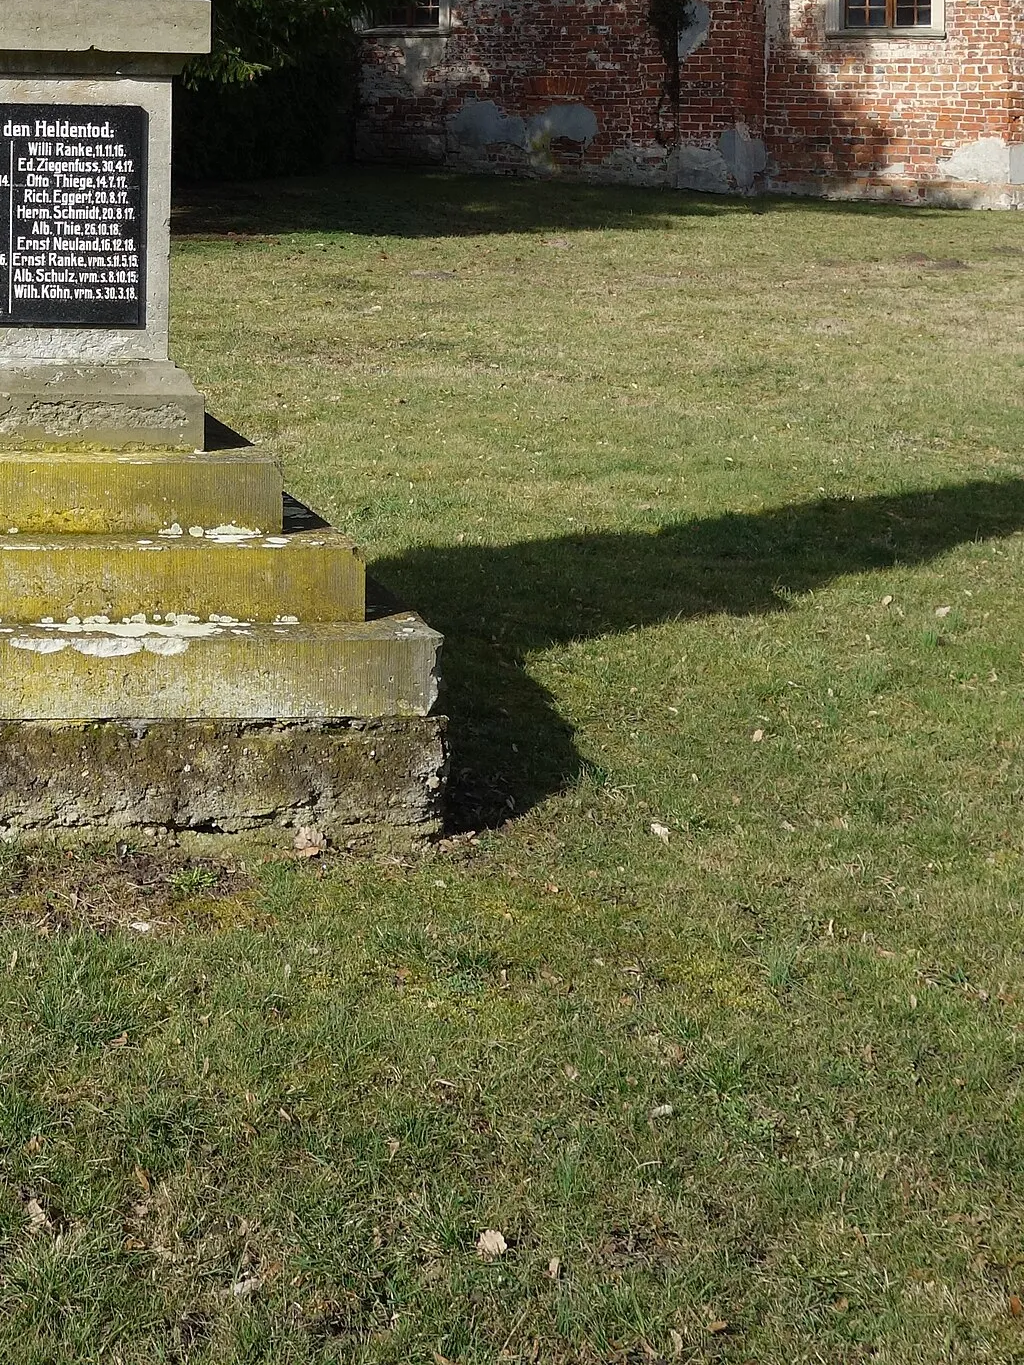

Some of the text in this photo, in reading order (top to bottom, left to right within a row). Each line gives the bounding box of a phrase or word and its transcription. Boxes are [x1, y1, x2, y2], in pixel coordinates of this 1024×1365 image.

[4, 120, 30, 137] den
[35, 120, 114, 138] Heldentod:
[28, 142, 52, 156] Willi
[27, 174, 49, 187] Otto
[17, 236, 50, 250] Ernst
[12, 253, 46, 266] Ernst
